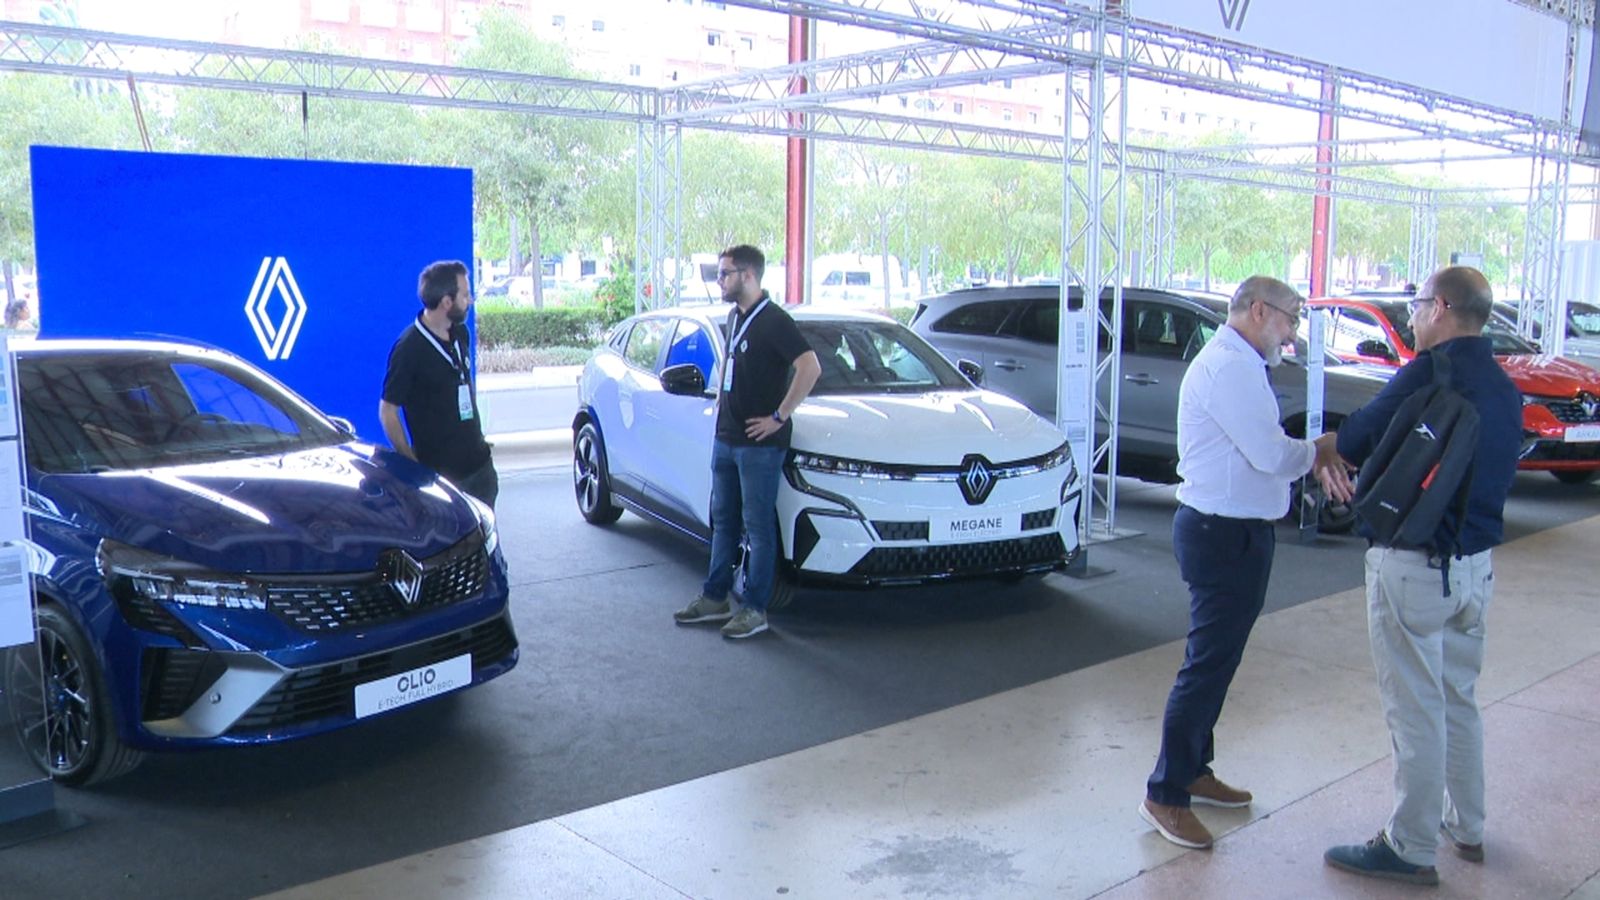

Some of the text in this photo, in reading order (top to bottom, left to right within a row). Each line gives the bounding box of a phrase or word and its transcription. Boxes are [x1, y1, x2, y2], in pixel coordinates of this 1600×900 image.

[950, 517, 1002, 531] MEGANE
[397, 668, 436, 693] CLIO
[408, 689, 425, 700] FULL
